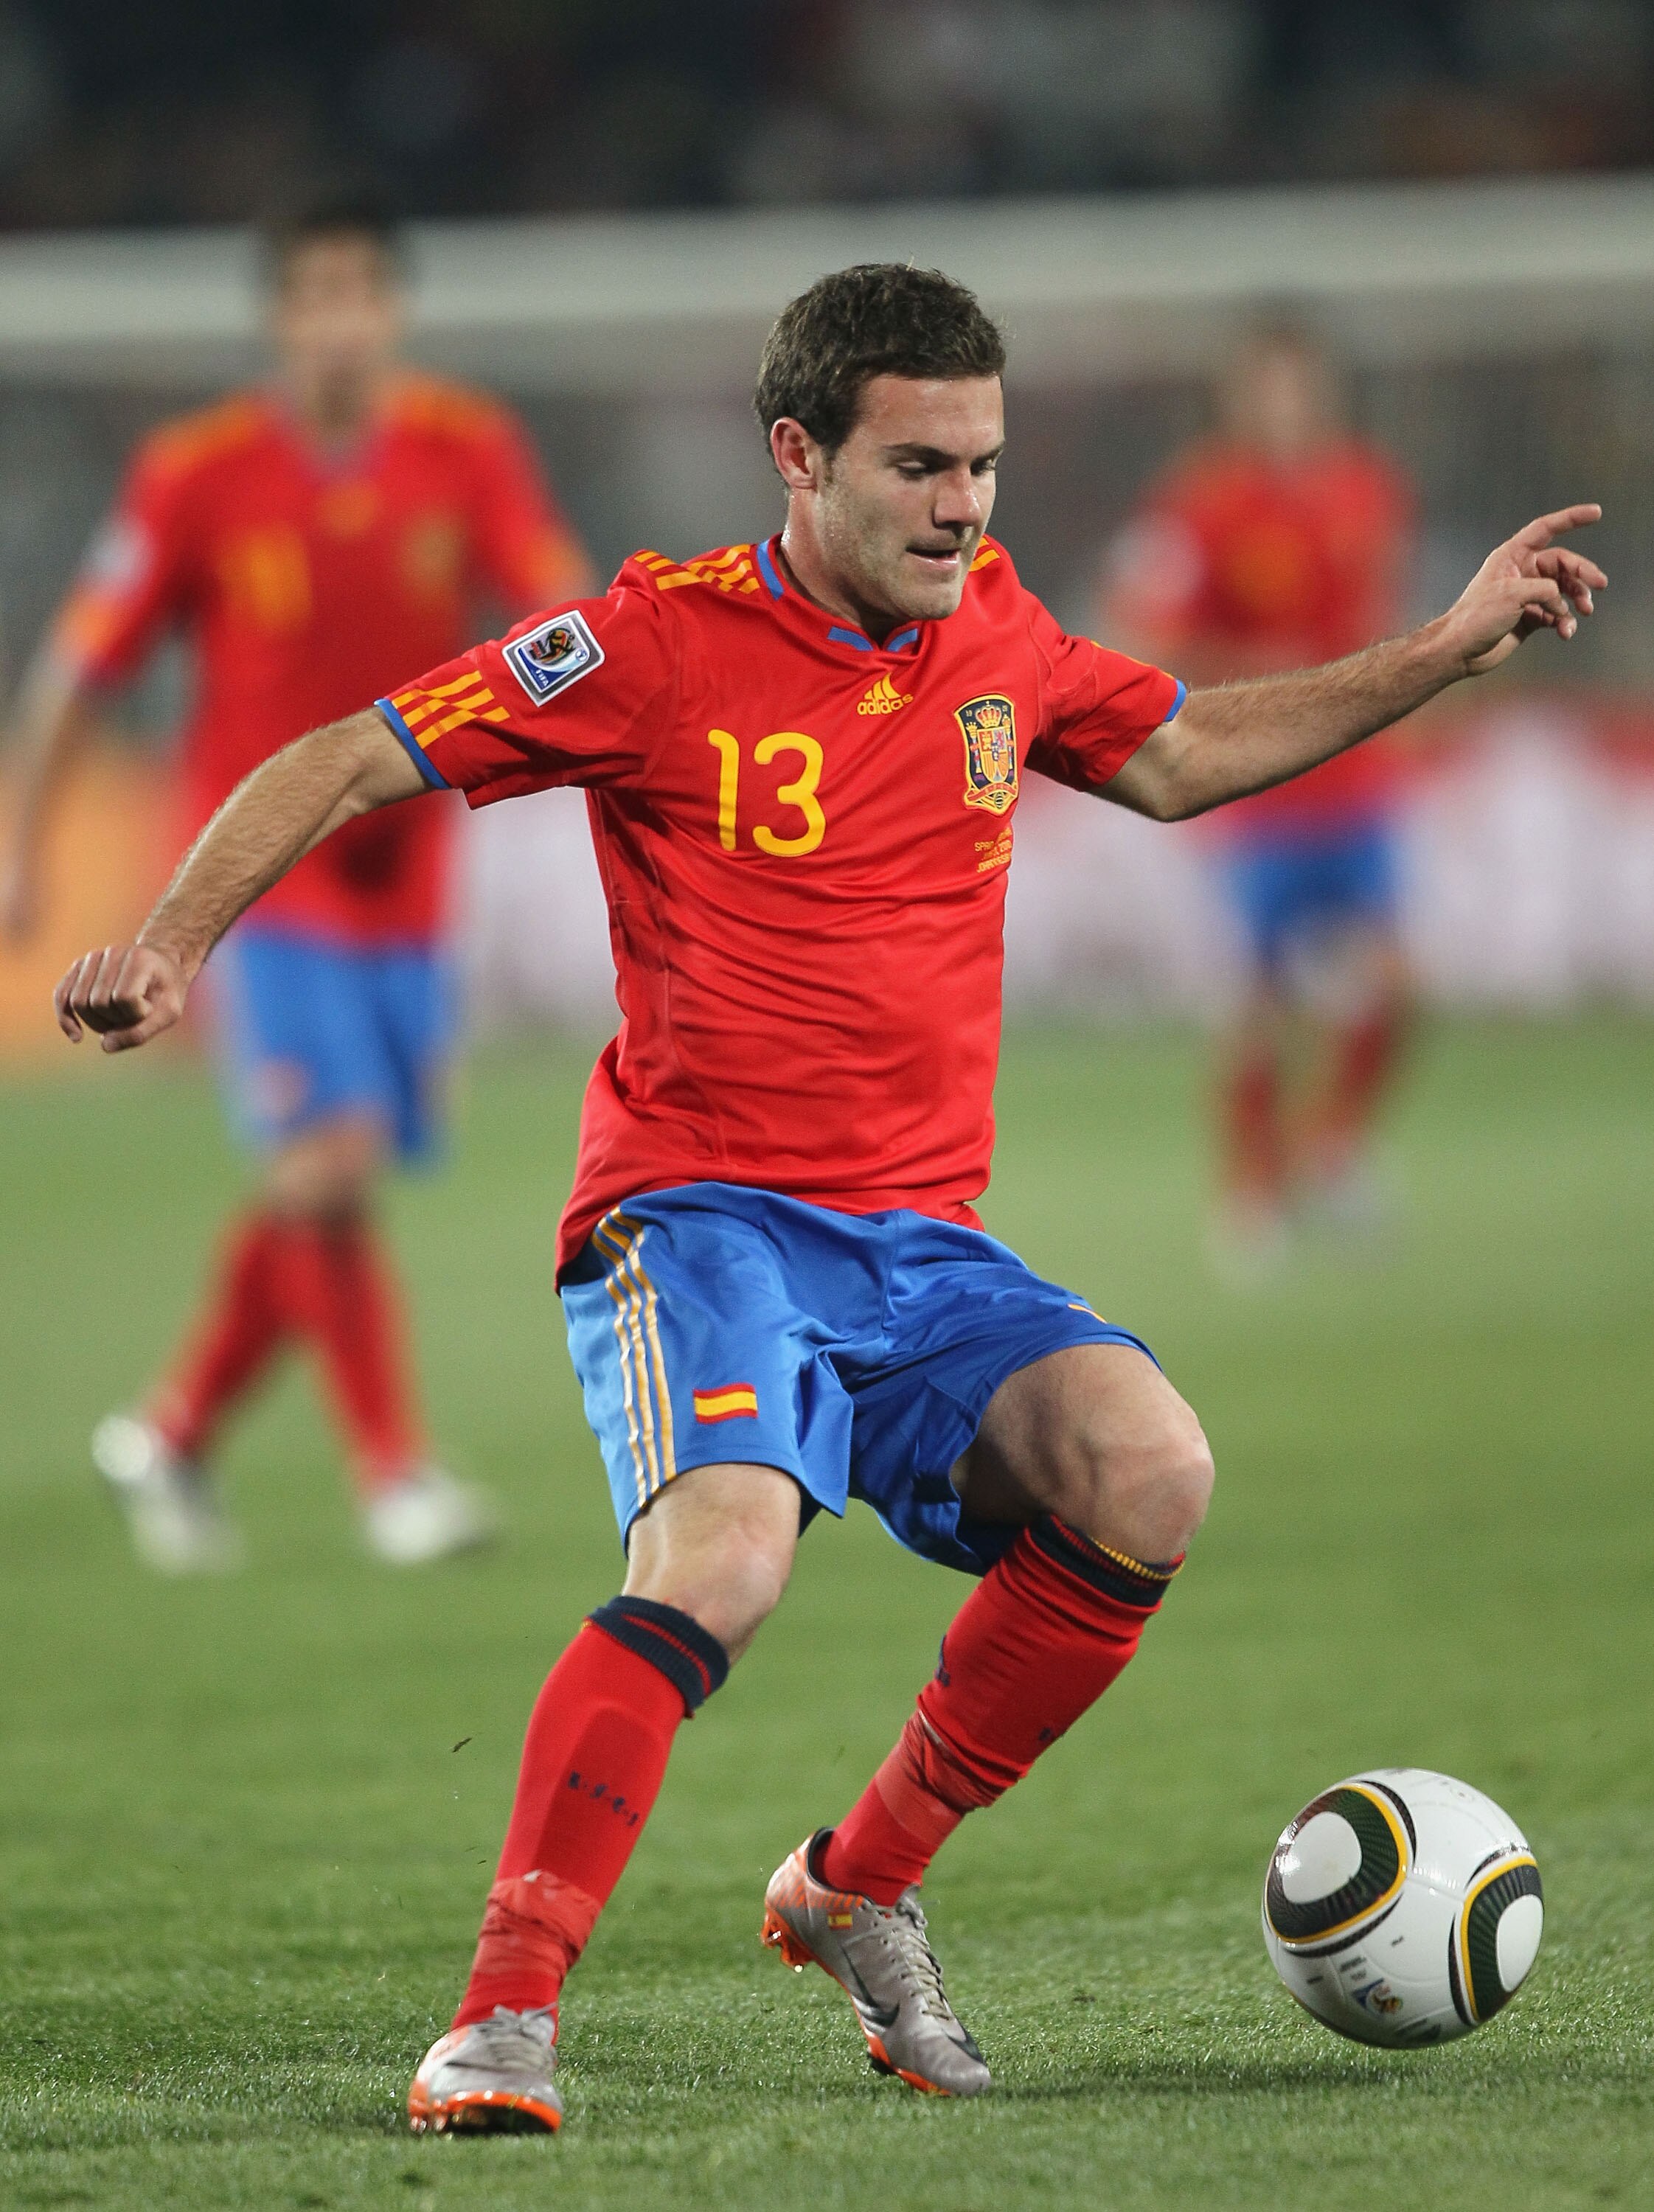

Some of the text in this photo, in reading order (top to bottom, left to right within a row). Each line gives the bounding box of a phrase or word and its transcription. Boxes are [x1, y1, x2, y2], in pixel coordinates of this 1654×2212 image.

[535, 669, 549, 686] FIFA
[857, 695, 914, 715] adidas
[707, 728, 826, 857] 13
